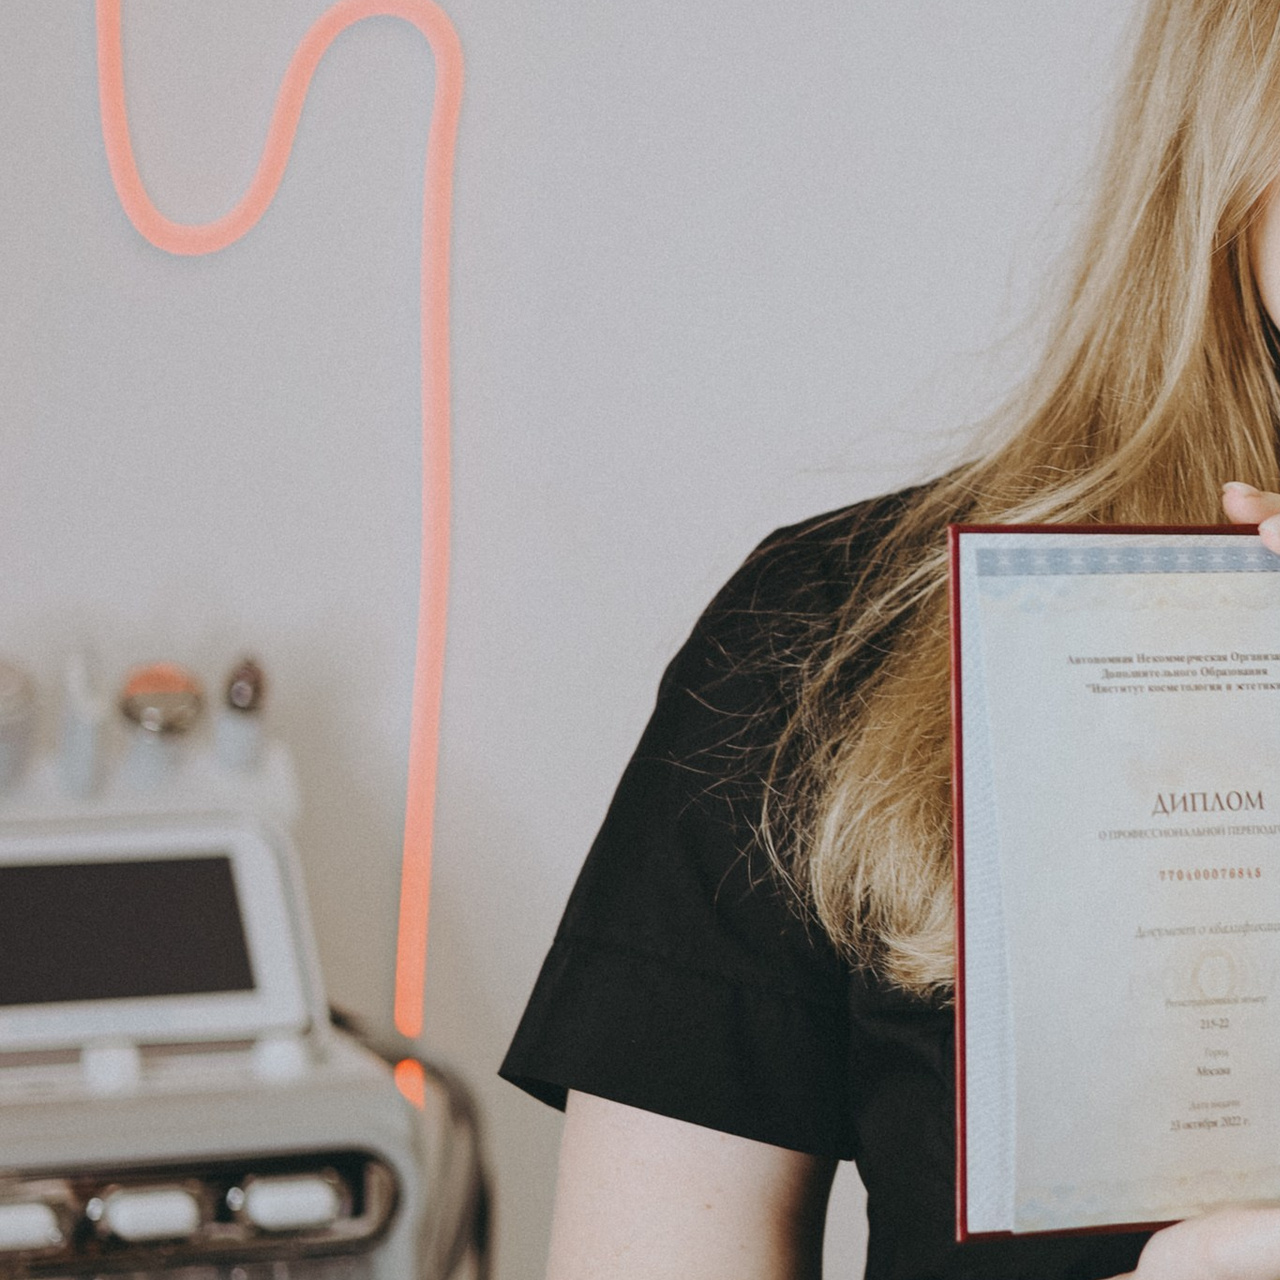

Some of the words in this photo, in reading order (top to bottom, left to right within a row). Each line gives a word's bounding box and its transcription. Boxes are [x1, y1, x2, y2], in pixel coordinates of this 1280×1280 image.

[1136, 652, 1228, 665] Некоммерческая
[1200, 665, 1269, 679] Образования
[1151, 789, 1266, 818] ДИПЛОМ
